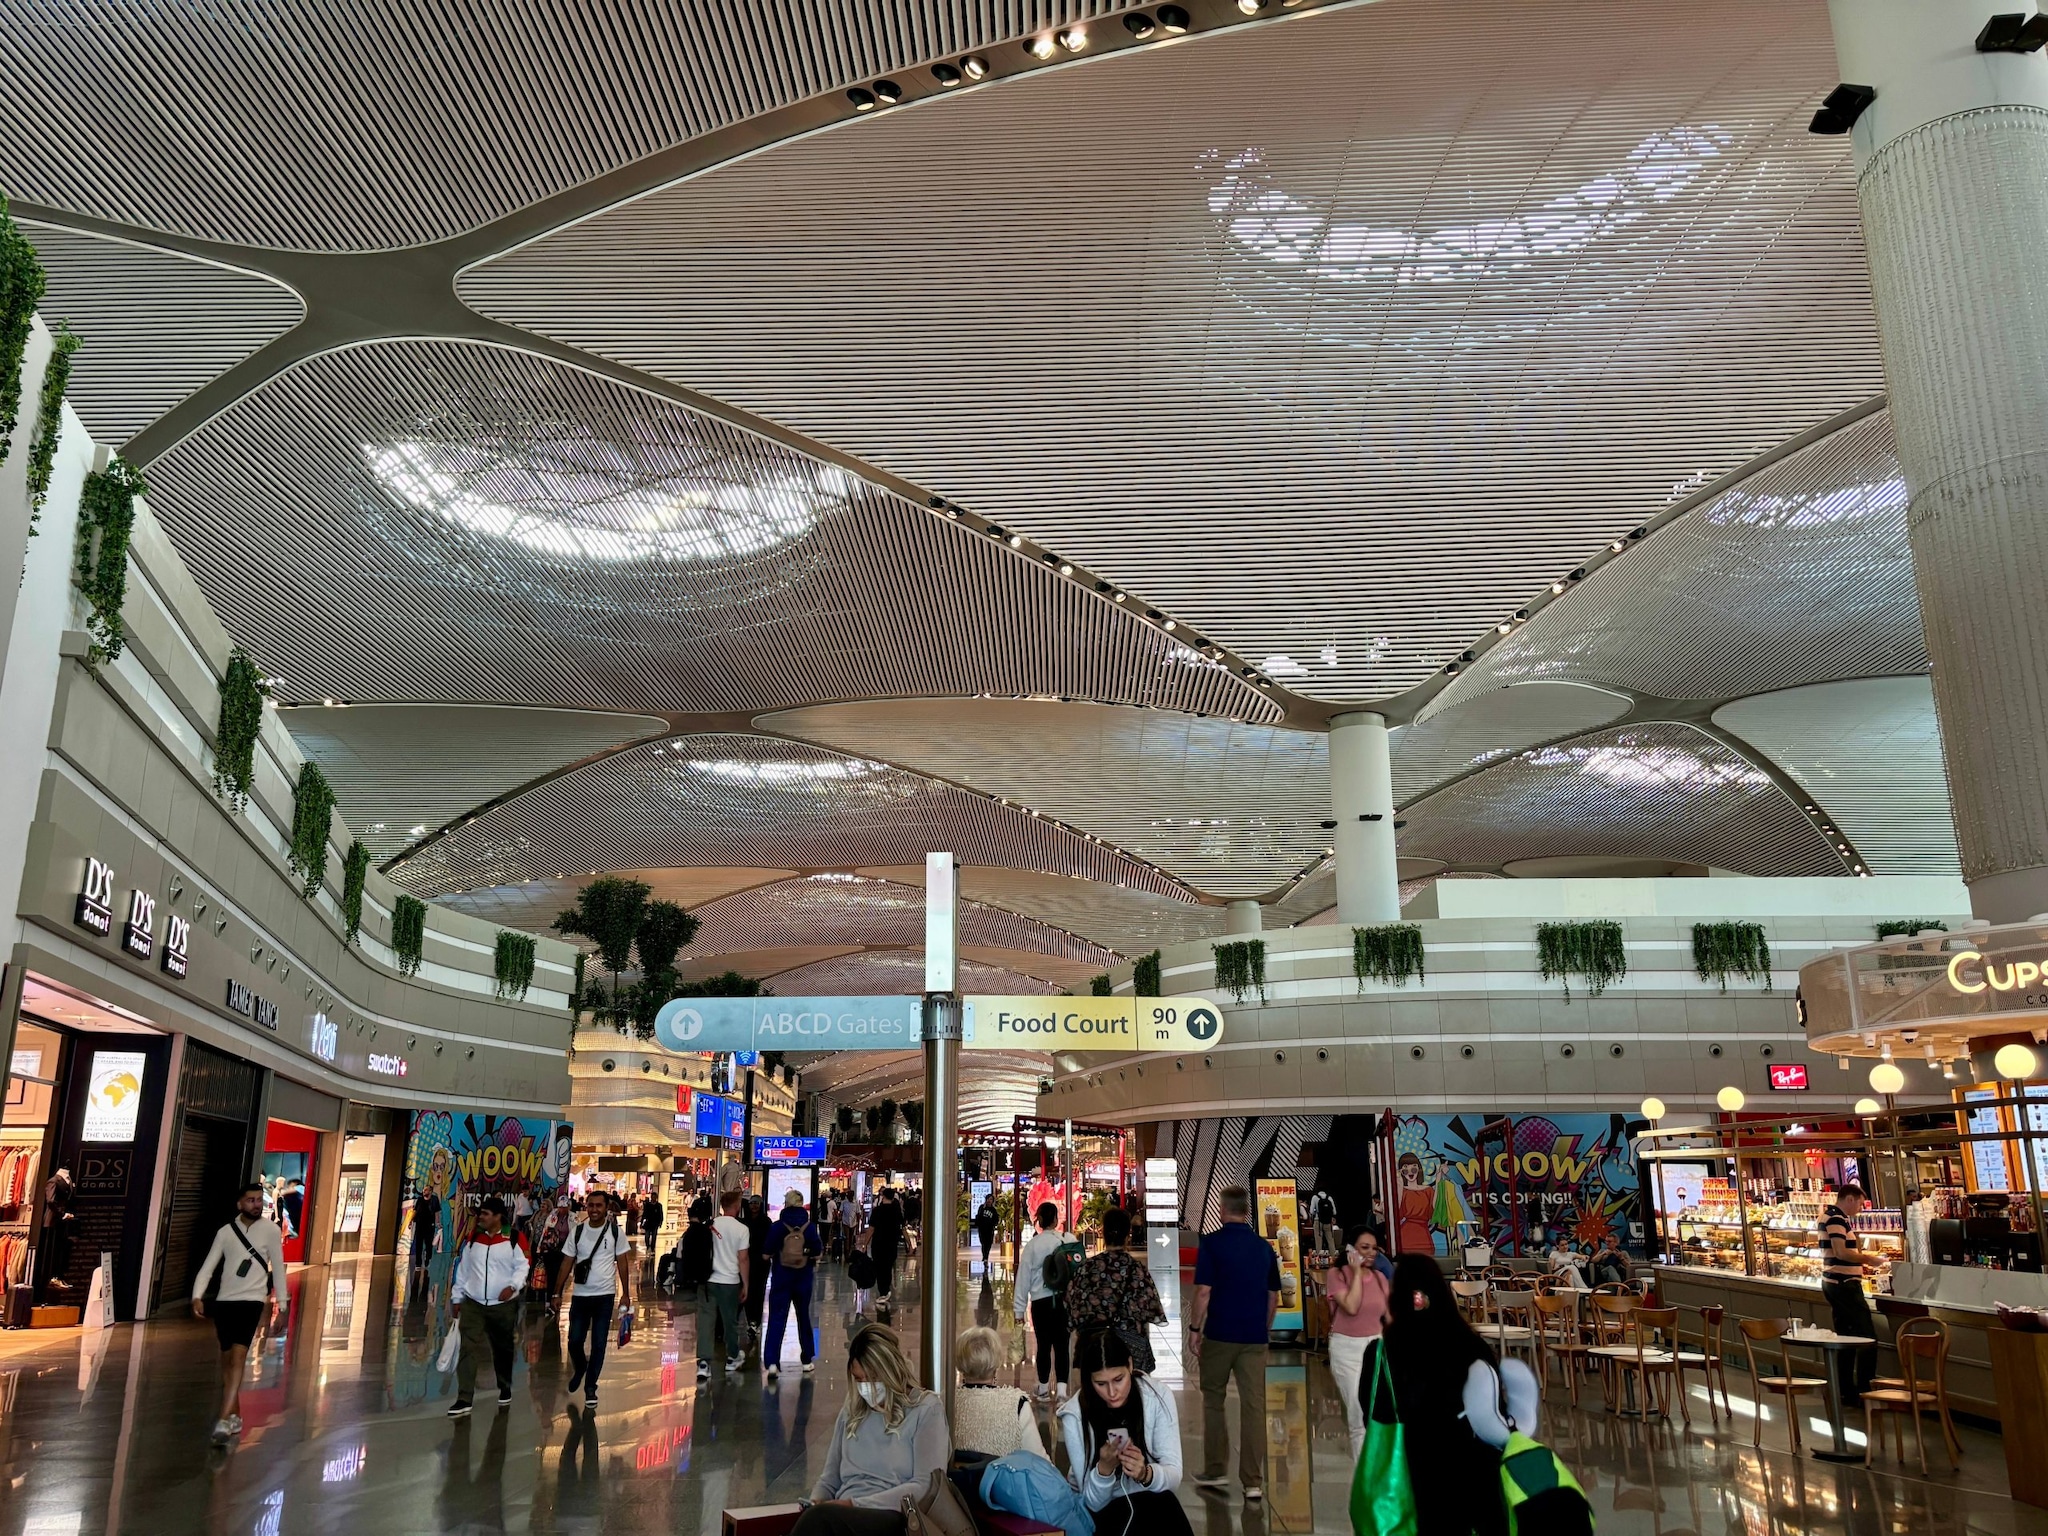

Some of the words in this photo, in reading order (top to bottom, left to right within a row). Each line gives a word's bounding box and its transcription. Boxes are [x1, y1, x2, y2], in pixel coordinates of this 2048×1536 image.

[85, 857, 114, 907] D'S
[131, 889, 155, 933] D'S
[168, 915, 190, 955] D'S
[228, 979, 254, 1018] TAMER
[256, 996, 280, 1031] TANCA
[1152, 1007, 1177, 1025] 90
[759, 1012, 832, 1035] ABCD
[837, 1013, 903, 1035] Gates
[998, 1012, 1056, 1034] Food
[1063, 1013, 1129, 1034] Court
[1156, 1029, 1169, 1040] m
[83, 1158, 126, 1178] D'S
[457, 1145, 544, 1183] WOOW
[1455, 1151, 1588, 1185] WOOW
[81, 1180, 121, 1189] damat
[463, 1193, 482, 1208] IT'S
